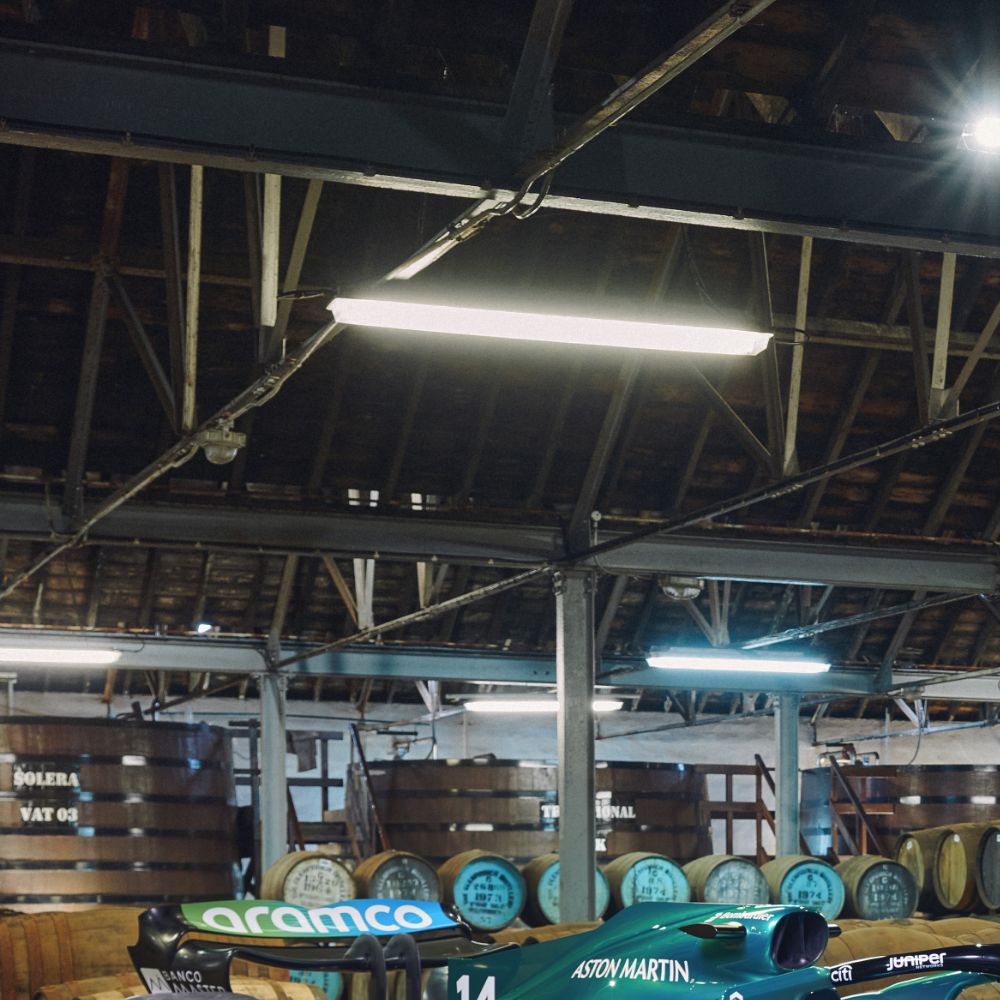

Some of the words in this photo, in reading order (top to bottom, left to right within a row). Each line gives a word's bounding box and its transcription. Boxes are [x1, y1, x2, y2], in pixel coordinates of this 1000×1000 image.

[13, 770, 80, 787] SOLERA
[20, 807, 54, 822] VAT
[56, 807, 78, 822] 03
[202, 904, 433, 934] aramco
[162, 970, 203, 983] BANCO
[571, 958, 621, 979] ASTON
[619, 958, 690, 983] MARTIN
[830, 965, 853, 982] citi
